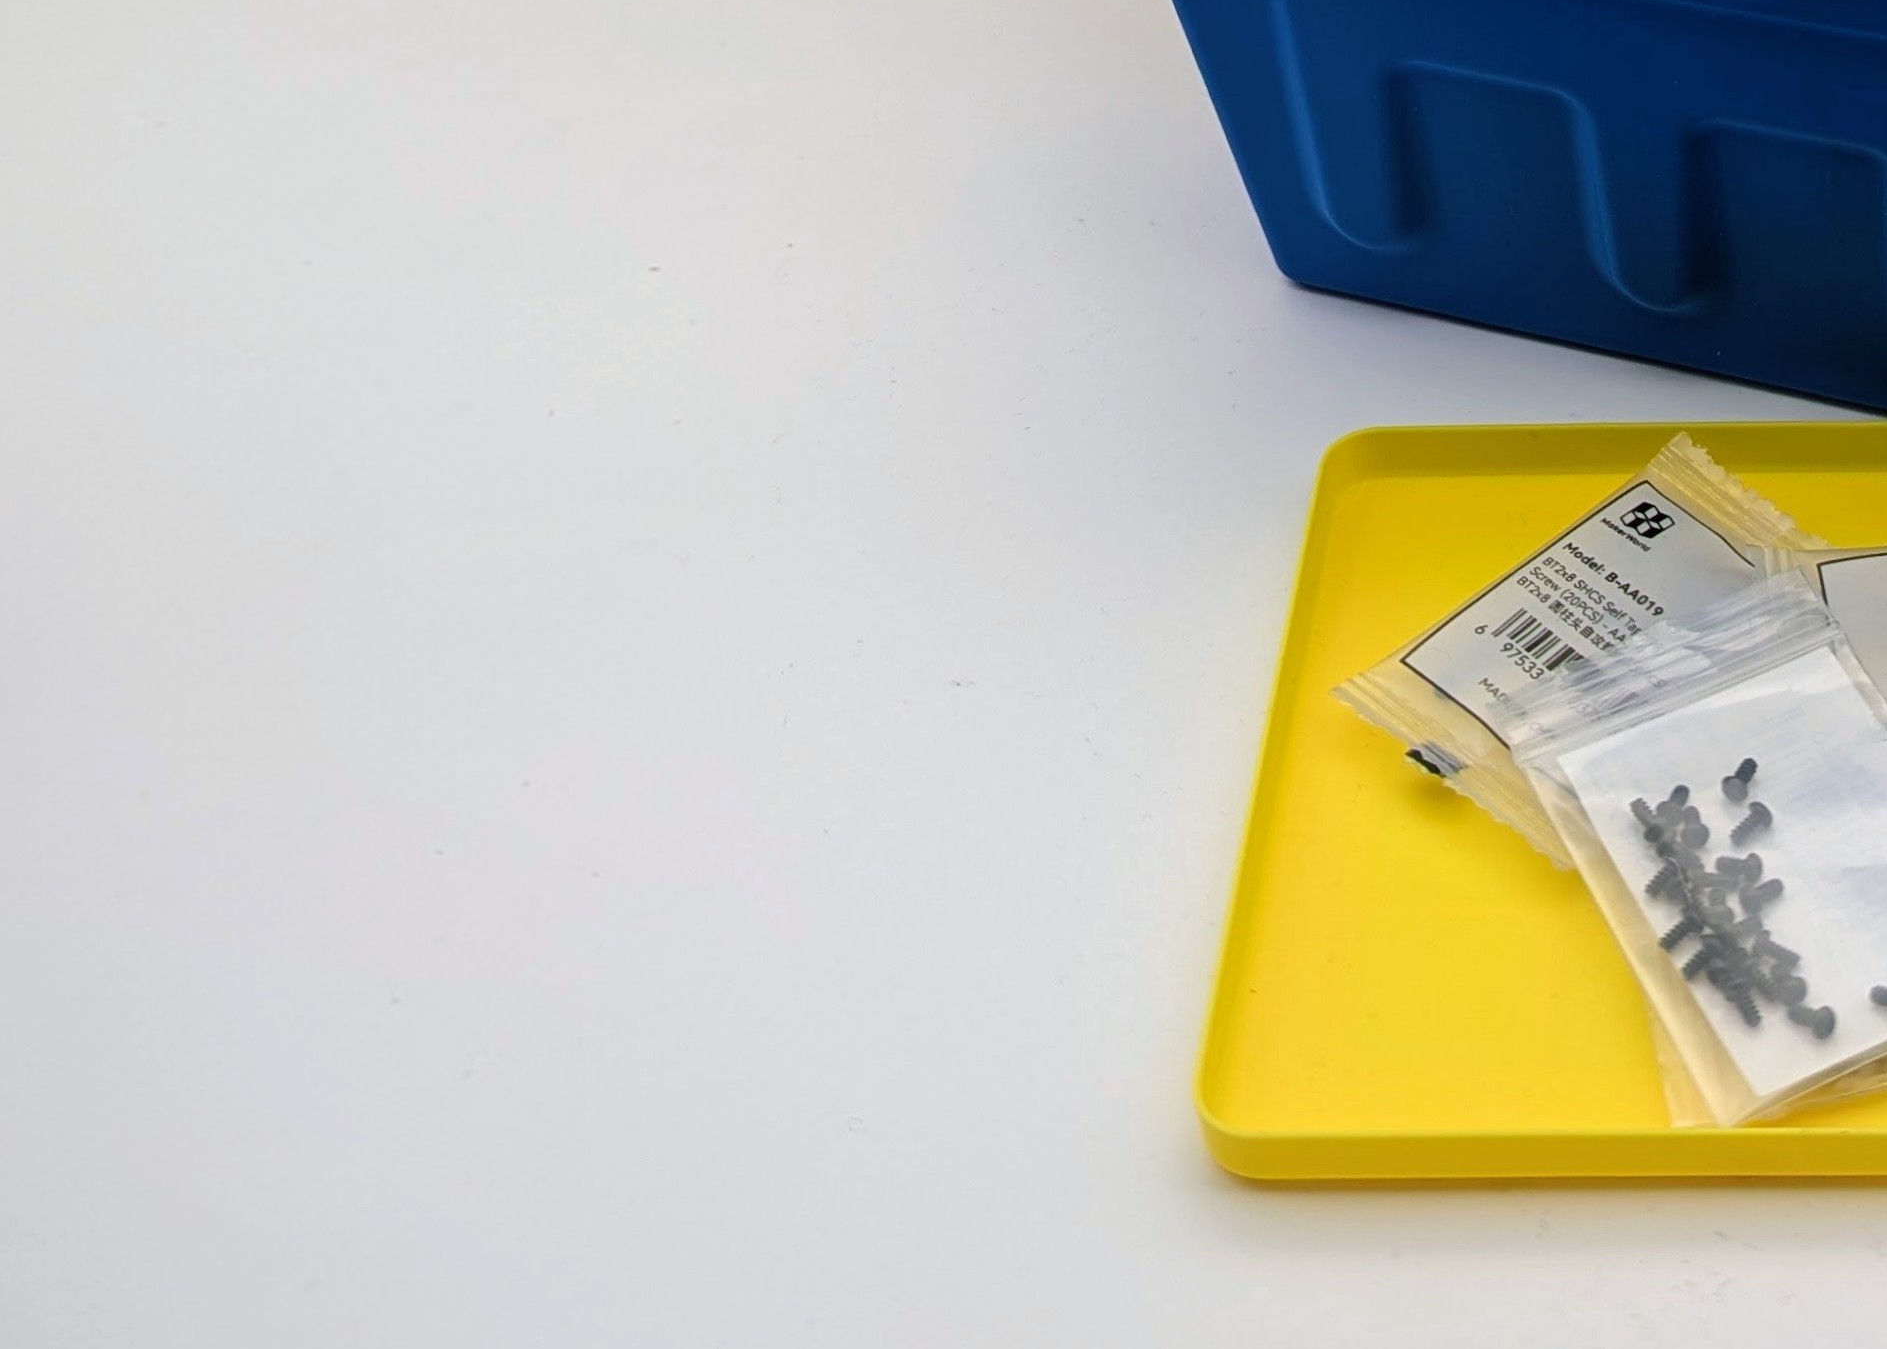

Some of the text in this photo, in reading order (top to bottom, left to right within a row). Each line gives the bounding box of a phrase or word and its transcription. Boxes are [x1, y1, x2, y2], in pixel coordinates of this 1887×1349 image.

[1516, 576, 1551, 604] BT2x8
[1529, 566, 1562, 592] Screw
[1559, 588, 1602, 625] (20PCS)
[1542, 556, 1577, 583] BT2x8
[1573, 579, 1603, 605] SHCS
[1602, 601, 1626, 622] Self
[1562, 542, 1664, 617] Model: B-AA019
[1474, 624, 1487, 635] 6
